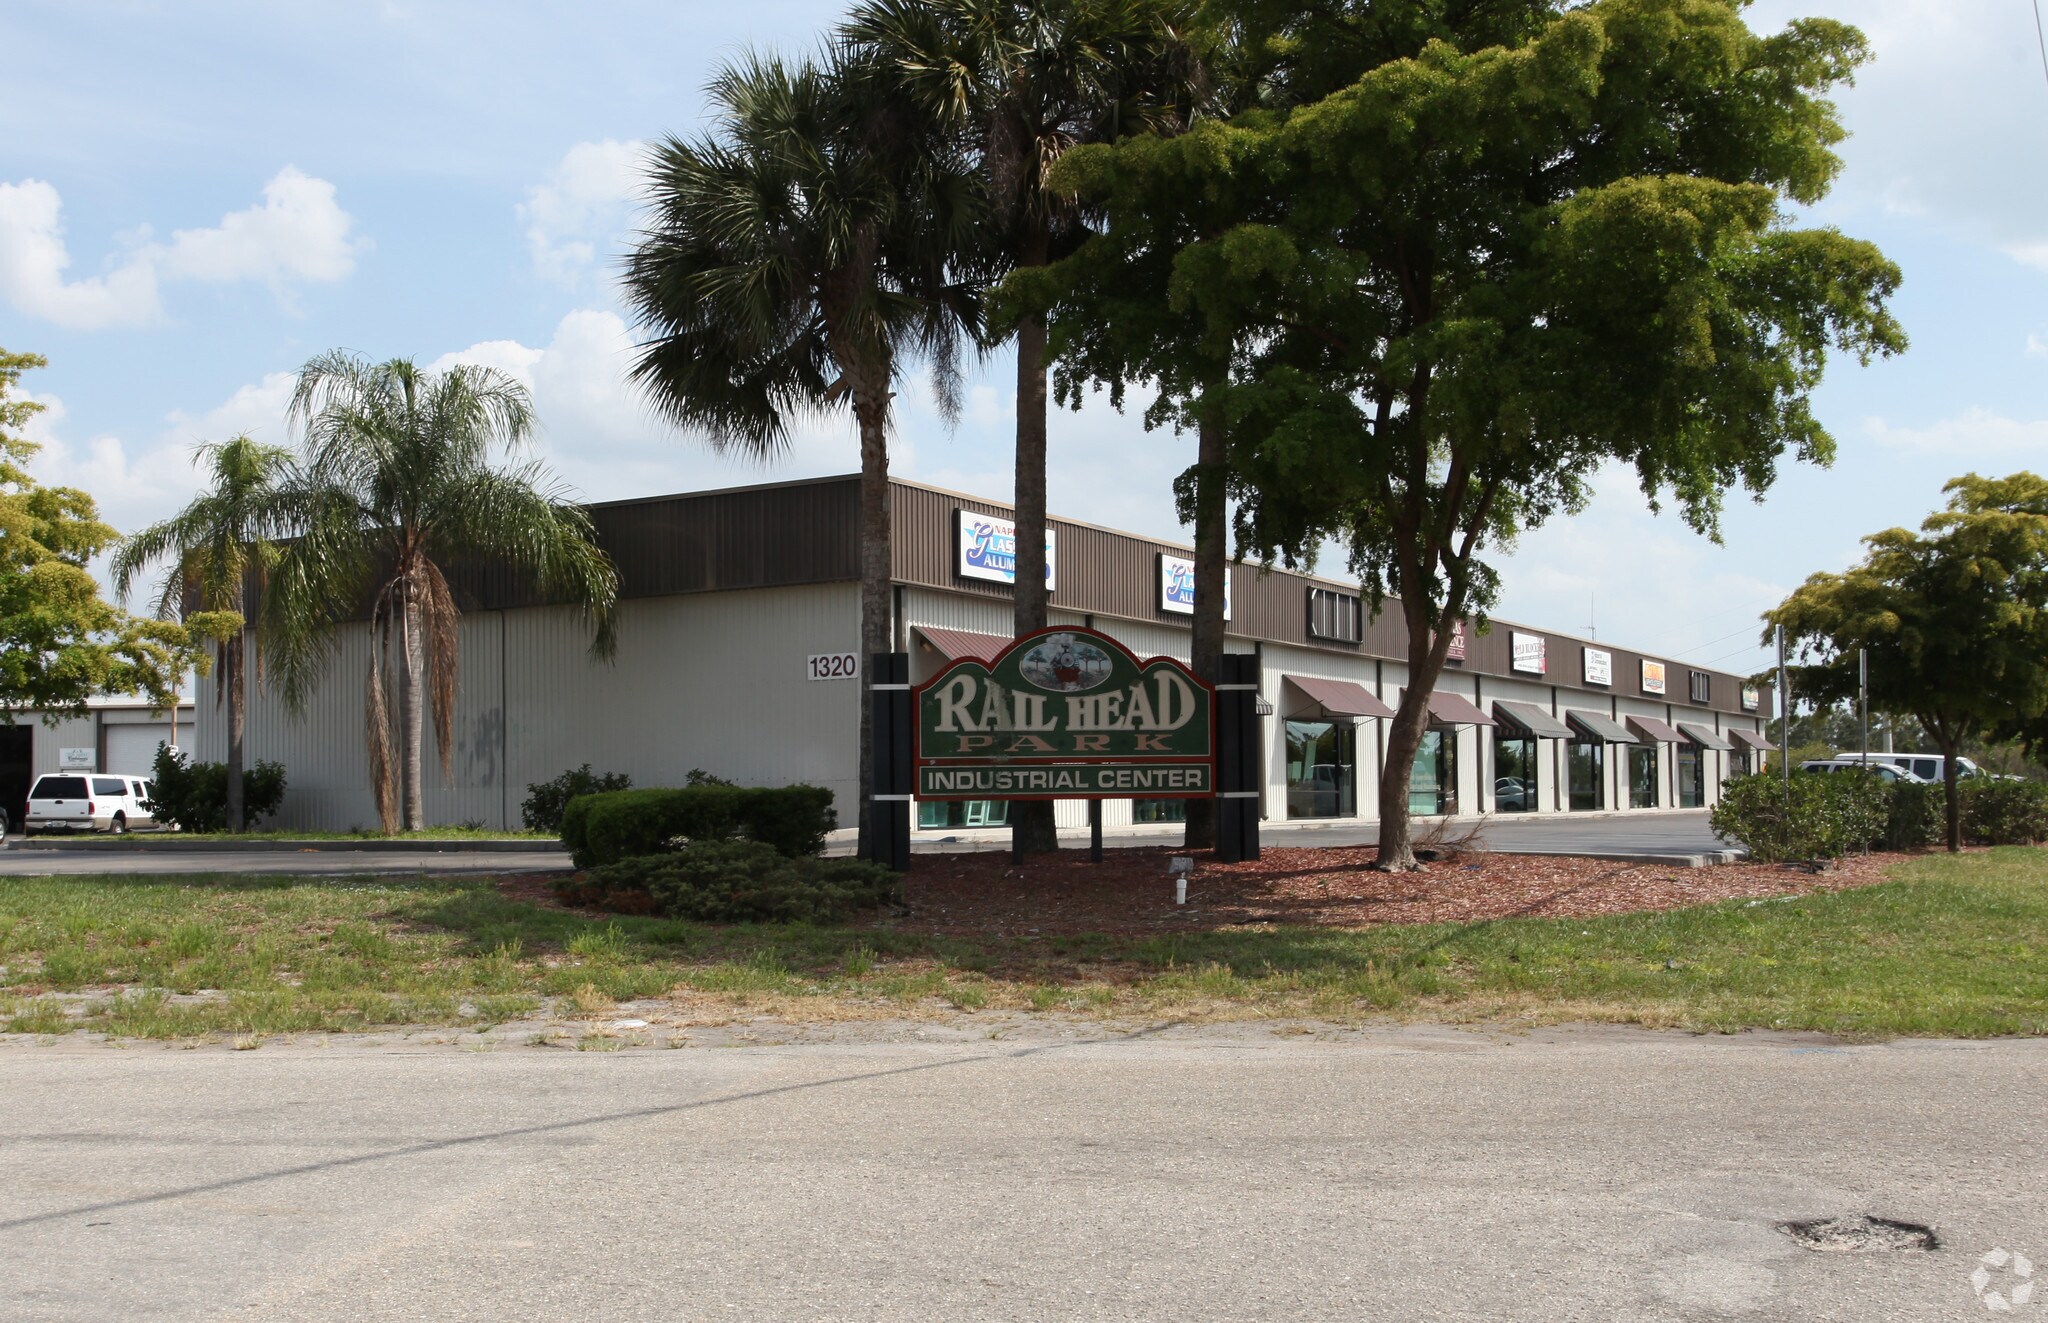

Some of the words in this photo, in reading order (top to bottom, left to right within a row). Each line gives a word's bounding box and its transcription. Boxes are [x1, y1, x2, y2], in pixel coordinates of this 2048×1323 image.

[995, 525, 1015, 536] NAP
[983, 554, 1015, 571] ALUM
[810, 655, 856, 677] 1320
[934, 674, 1059, 732] RAIL
[1065, 669, 1196, 732] HEAD
[956, 734, 1173, 752] PARK
[928, 770, 1089, 790] INDUSTRIAL
[1098, 769, 1202, 788] CENTER
